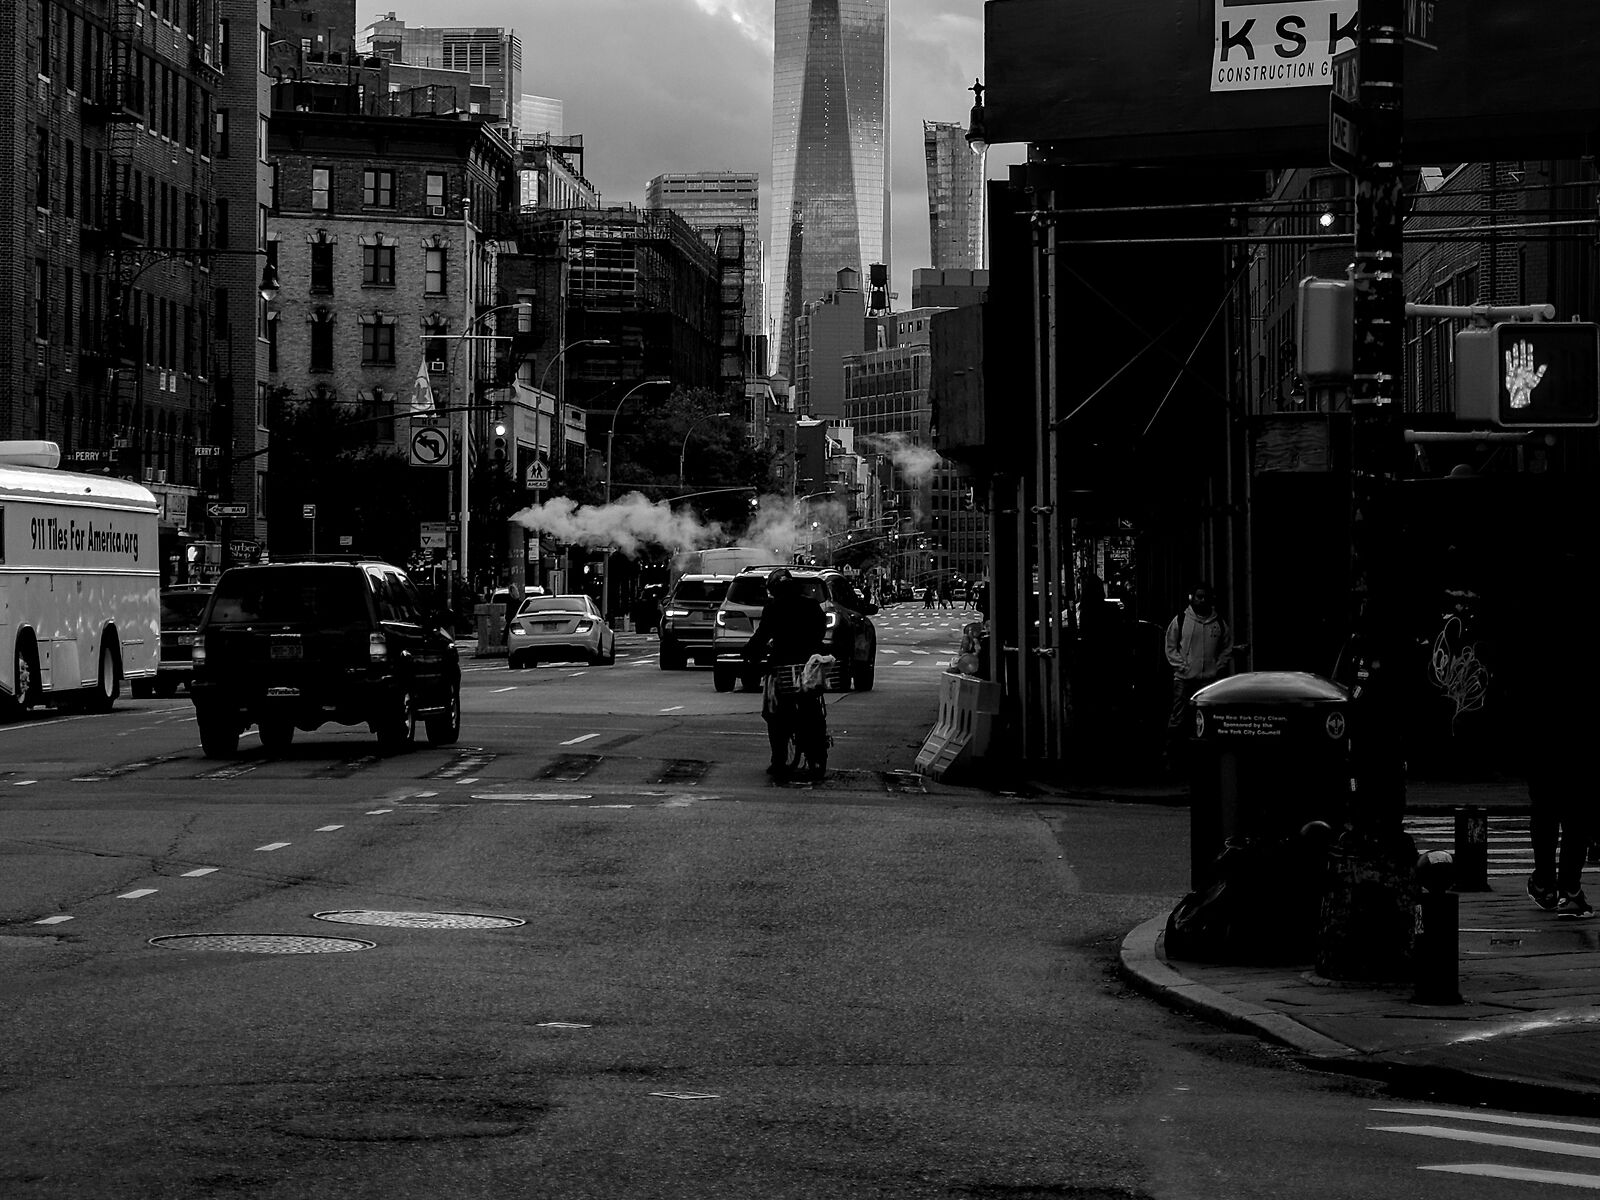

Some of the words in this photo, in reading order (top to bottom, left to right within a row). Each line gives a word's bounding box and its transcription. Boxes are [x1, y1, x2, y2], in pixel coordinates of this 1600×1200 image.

[1218, 62, 1314, 83] CONSTRUCTION
[1321, 60, 1333, 76] G
[75, 452, 99, 461] PERRY
[194, 447, 211, 456] PERRY
[213, 447, 220, 455] ST
[31, 517, 45, 550] 911
[47, 518, 68, 550] Tiles
[70, 520, 85, 551] For
[87, 521, 138, 562] America.org
